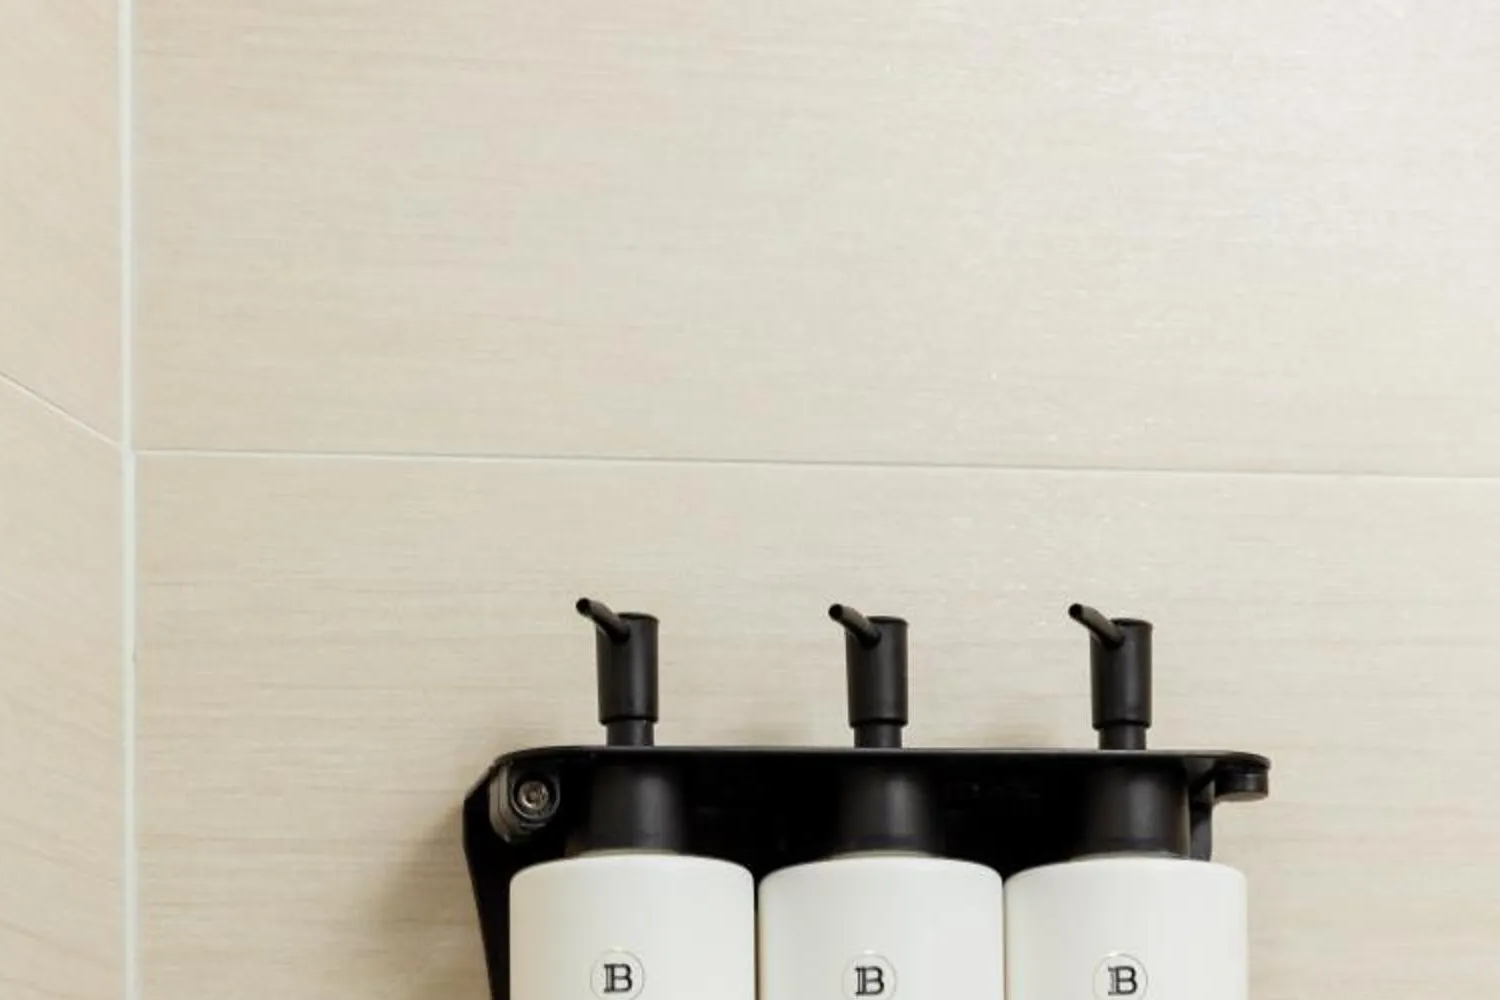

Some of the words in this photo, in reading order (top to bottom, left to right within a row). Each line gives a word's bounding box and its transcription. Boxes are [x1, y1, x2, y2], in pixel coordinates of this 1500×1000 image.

[603, 963, 633, 993] B
[854, 966, 885, 996] B
[1107, 966, 1138, 996] B
